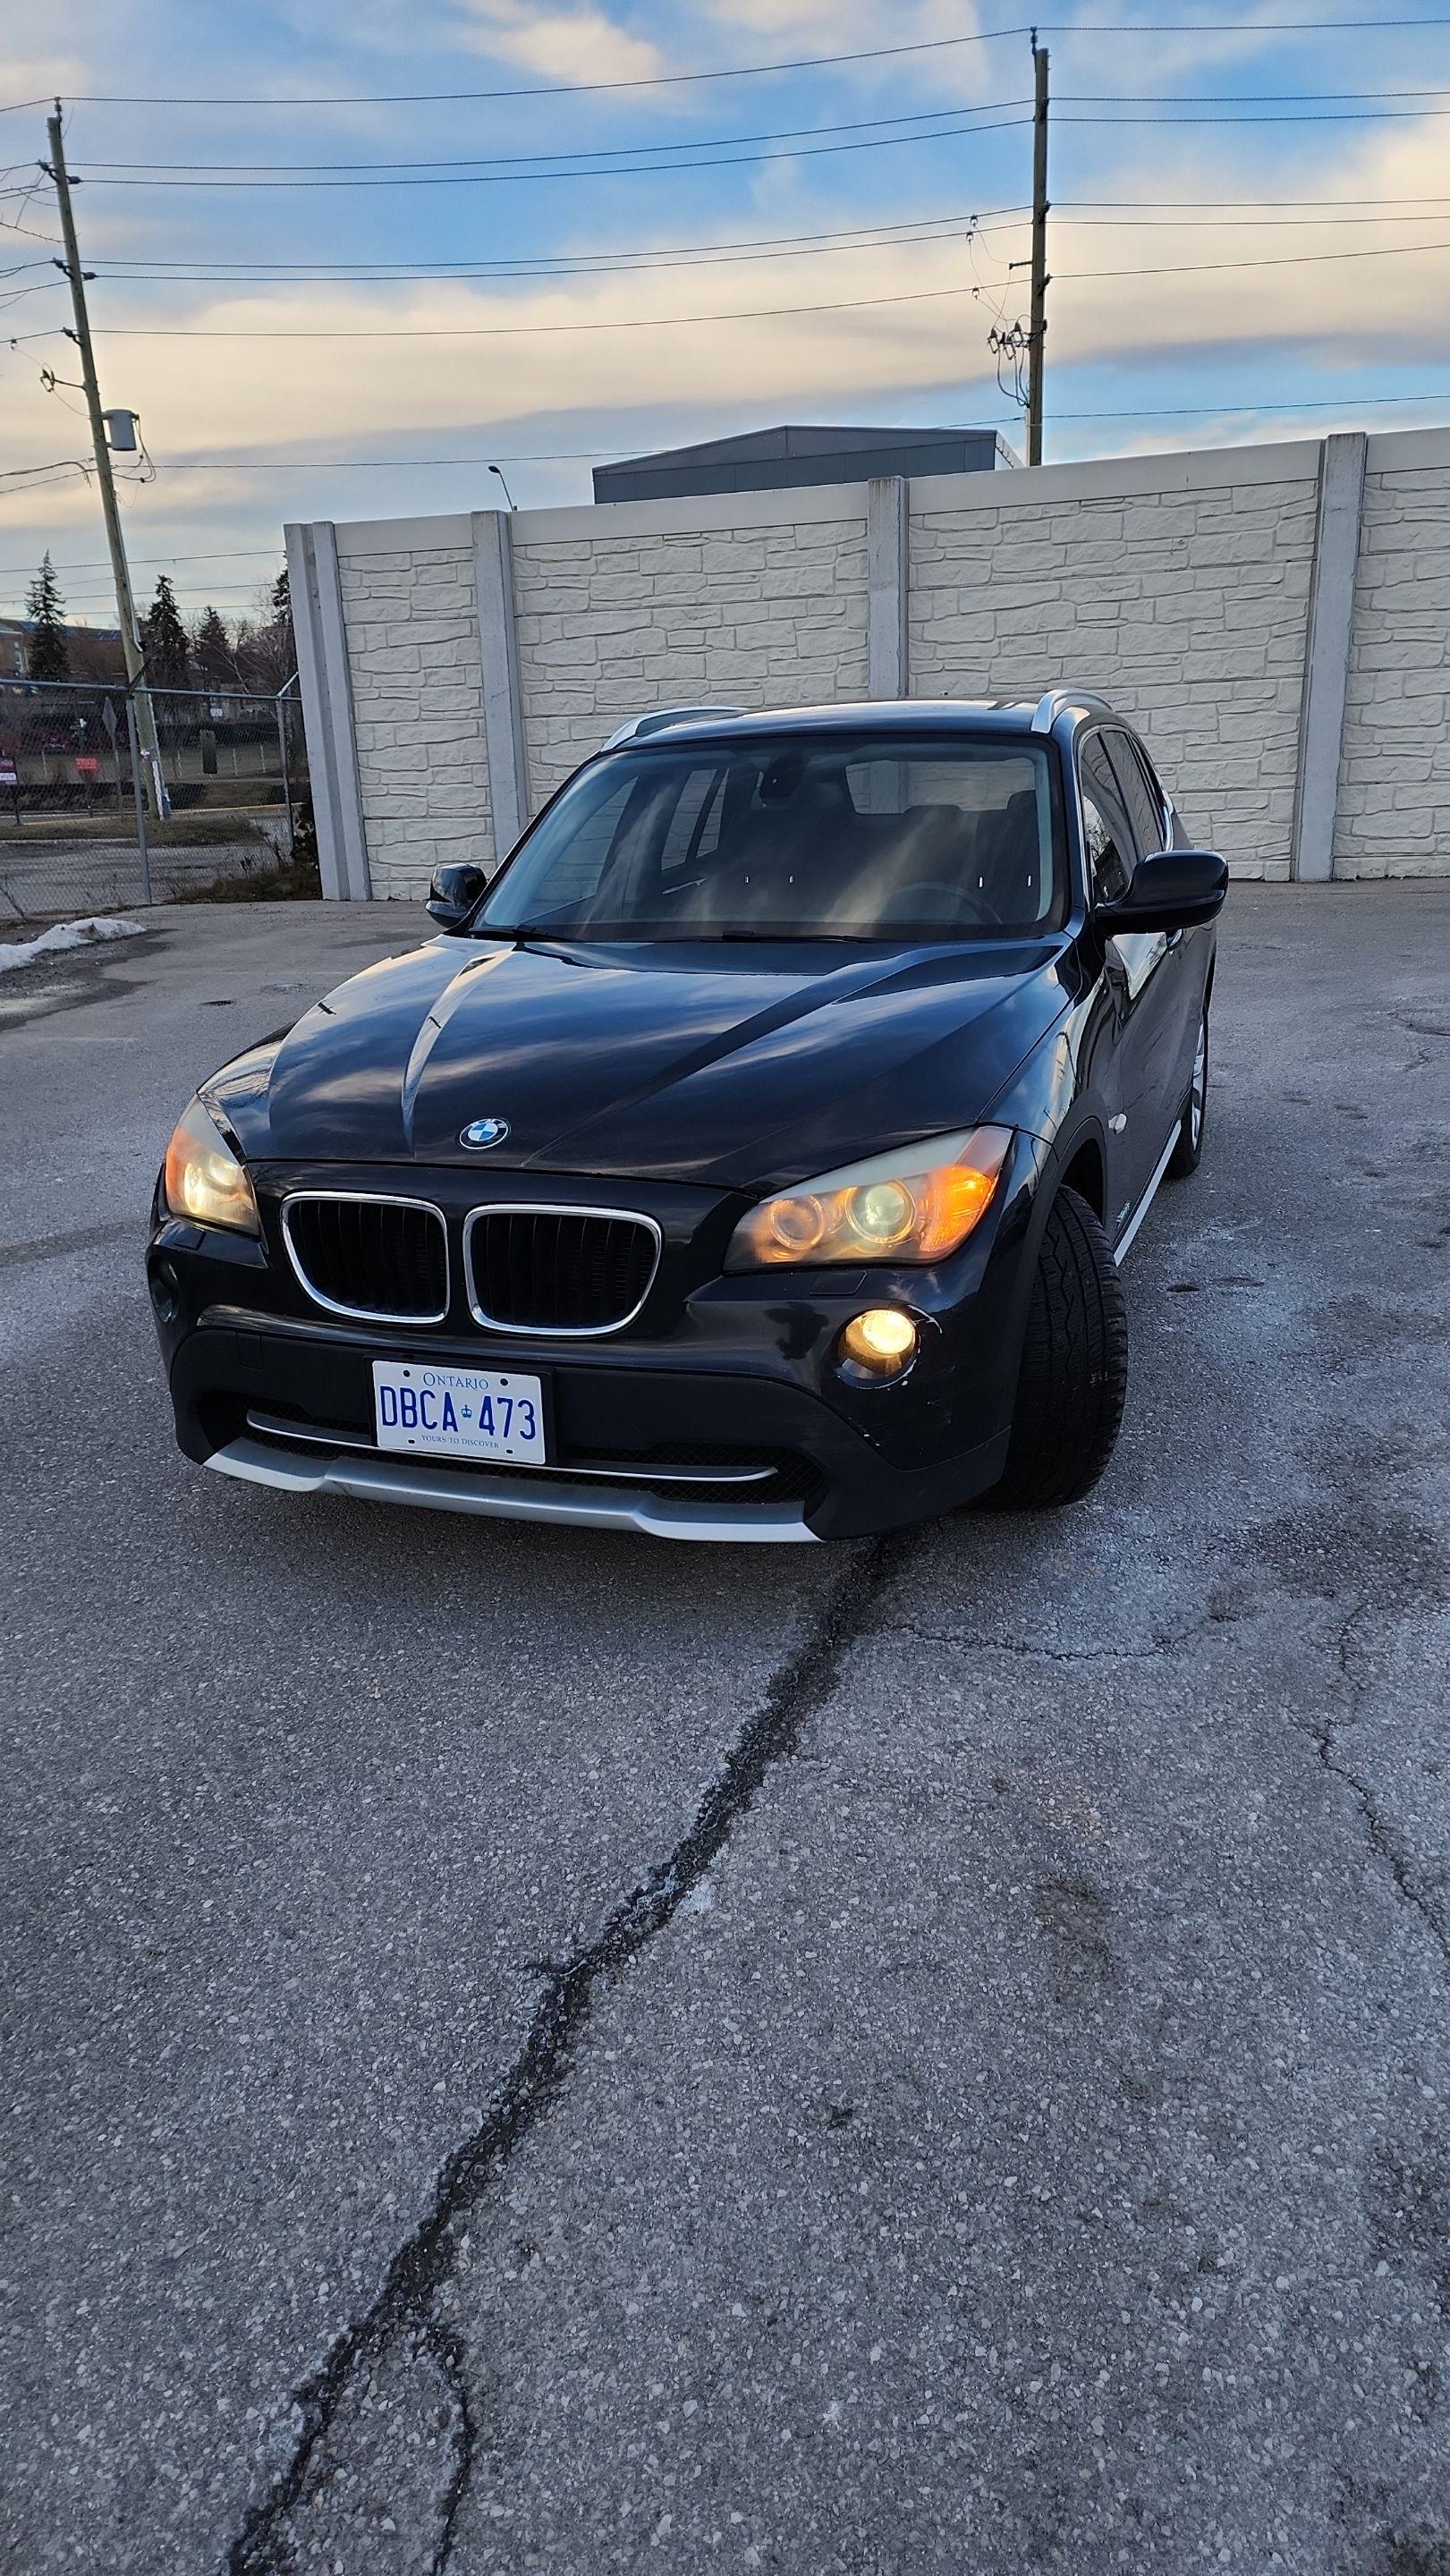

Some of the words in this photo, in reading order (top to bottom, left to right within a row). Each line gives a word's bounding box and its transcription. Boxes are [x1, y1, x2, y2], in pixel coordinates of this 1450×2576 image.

[423, 1372, 489, 1391] ONTARIO
[380, 1386, 459, 1432] DBCA
[479, 1395, 536, 1440] 473
[421, 1435, 446, 1444] YOURS
[449, 1436, 460, 1445] TO
[462, 1438, 499, 1449] DISCOVER
